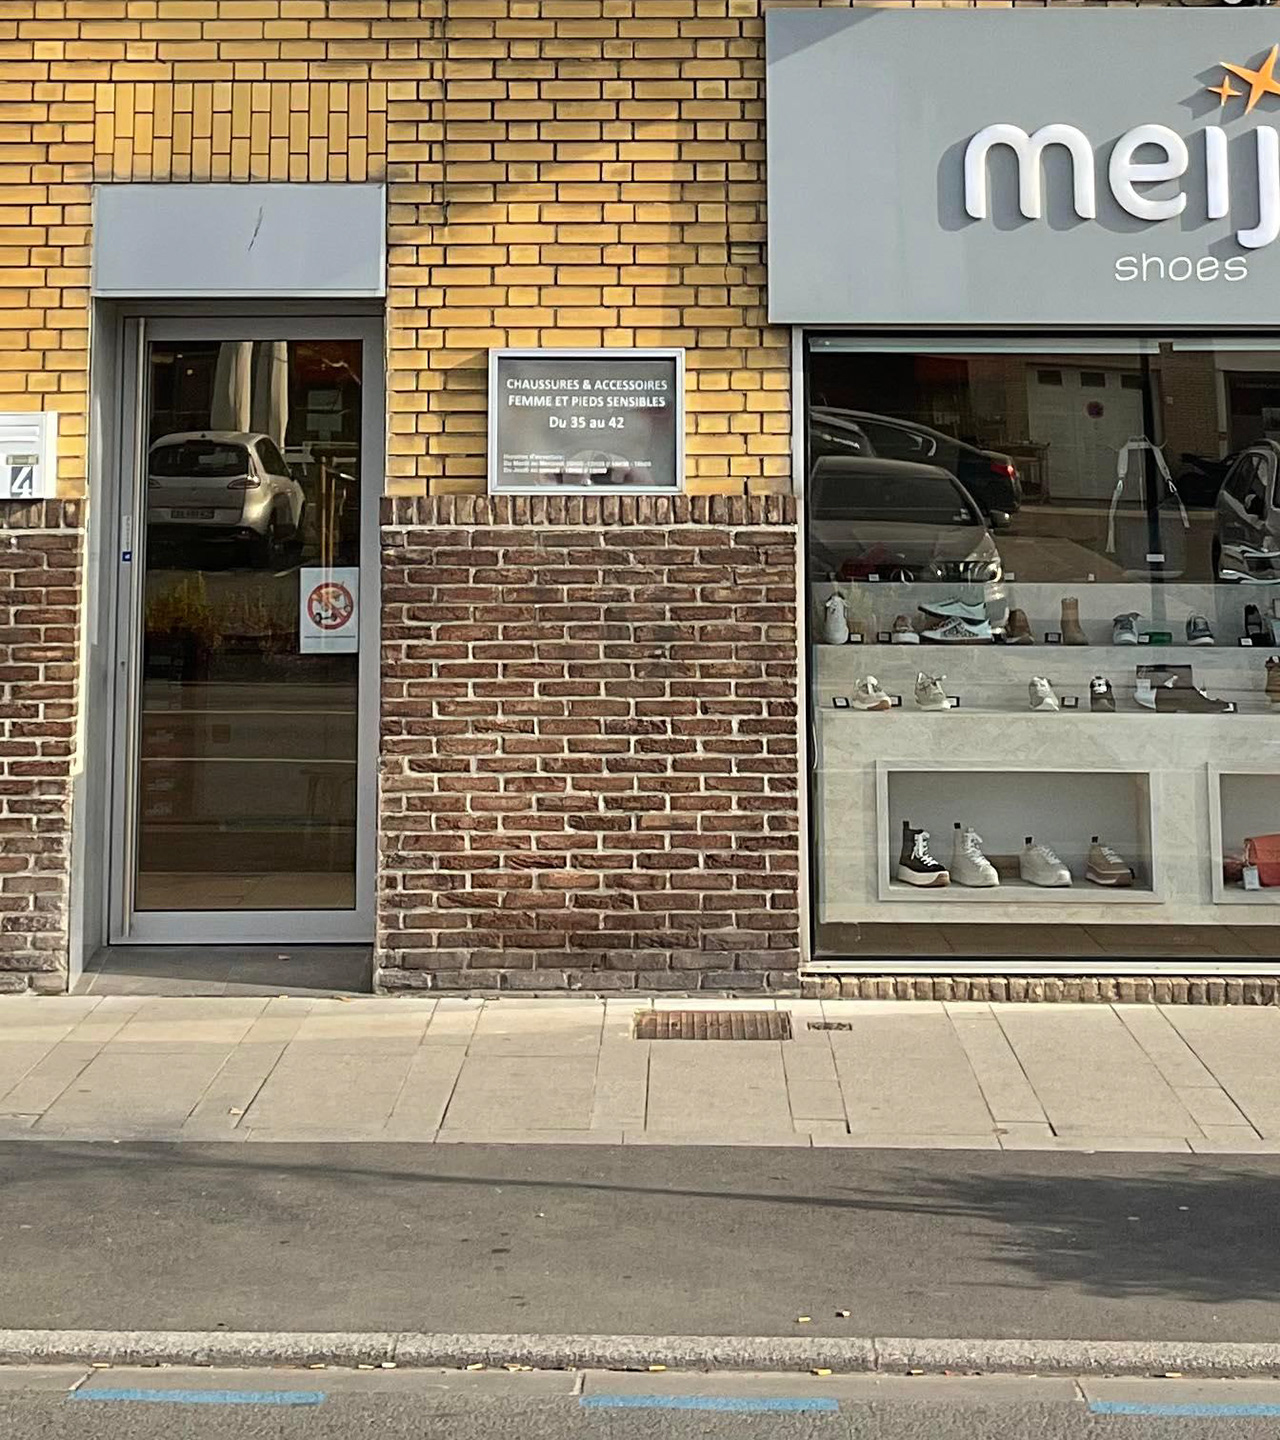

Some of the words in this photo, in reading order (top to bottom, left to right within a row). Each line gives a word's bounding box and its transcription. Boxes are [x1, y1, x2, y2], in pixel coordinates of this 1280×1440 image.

[1114, 253, 1249, 283] shoes
[506, 378, 580, 390] CHAUSSURES
[582, 379, 592, 390] &
[593, 379, 668, 391] ACCESSOIRES
[508, 394, 552, 407] FEMME
[555, 395, 569, 407] ET
[571, 395, 604, 407] PIEDS
[606, 396, 666, 408] SENSIBLES
[549, 416, 567, 428] Du
[570, 416, 586, 429] 35
[589, 418, 605, 429] au
[608, 416, 625, 429] 42
[11, 465, 32, 497] 4
